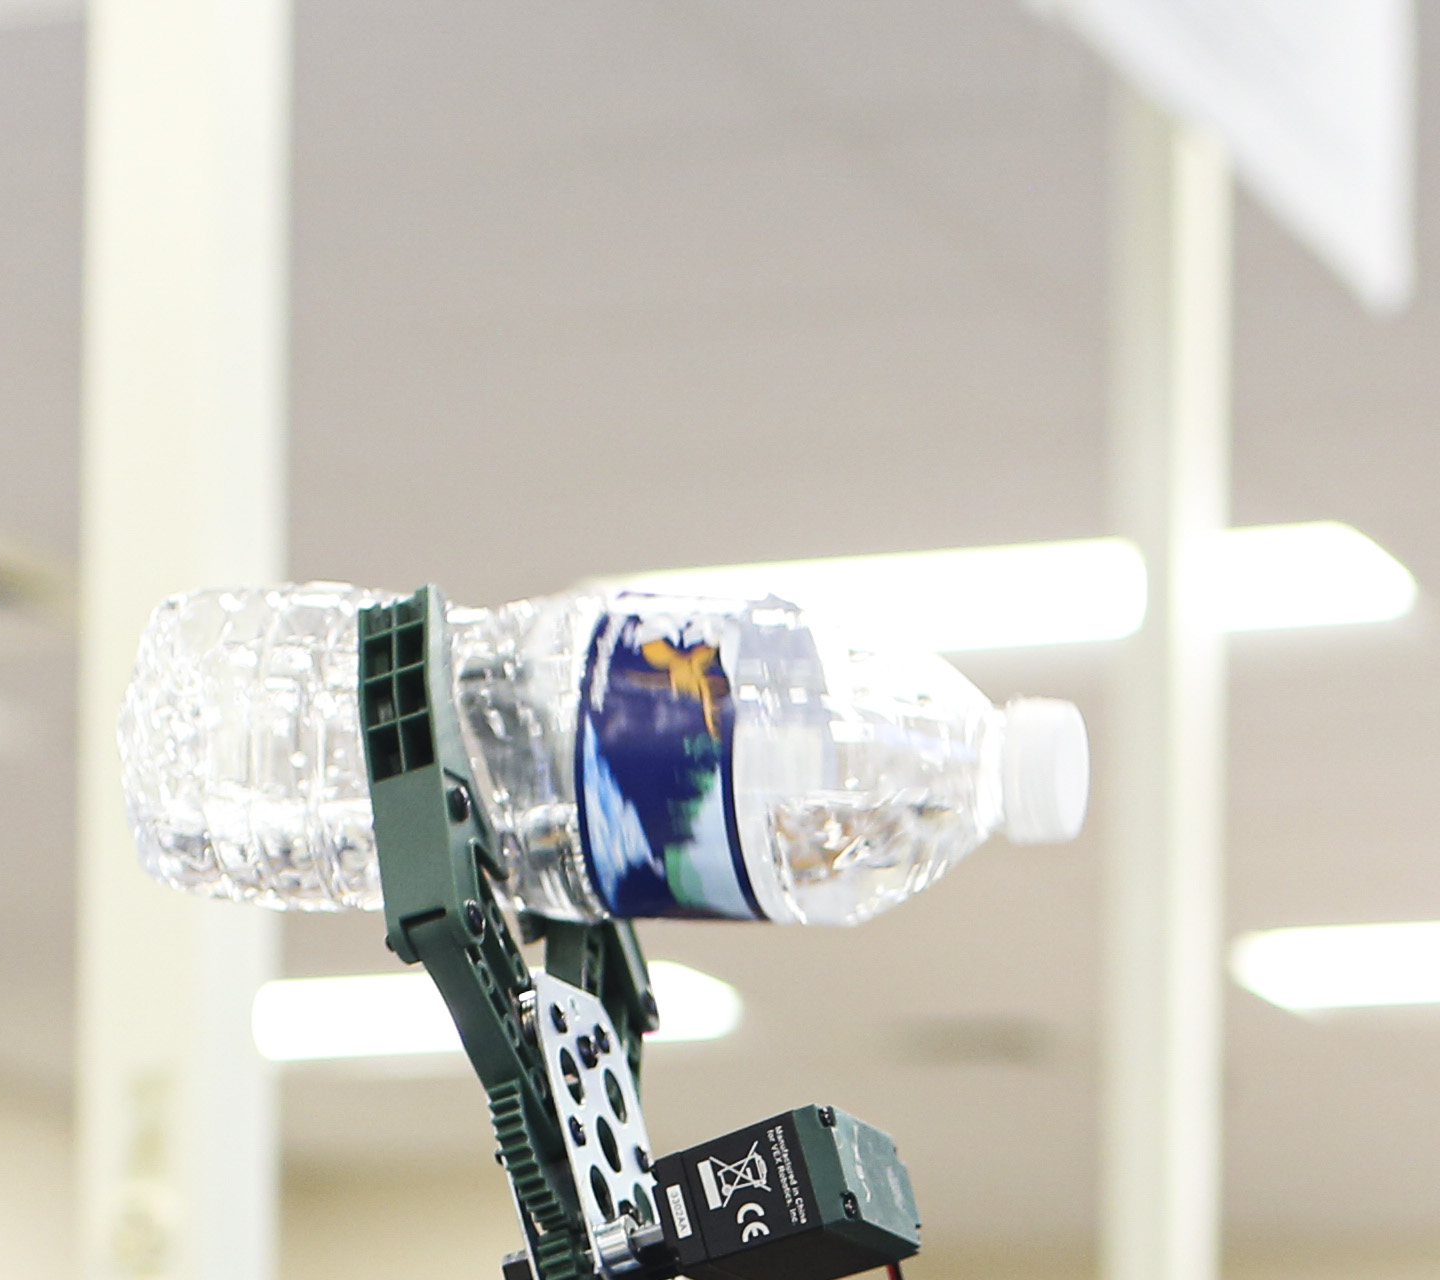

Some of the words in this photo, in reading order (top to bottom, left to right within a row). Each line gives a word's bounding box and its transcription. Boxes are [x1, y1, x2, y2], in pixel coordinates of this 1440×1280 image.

[767, 1129, 776, 1142] for
[771, 1143, 782, 1165] VEX
[775, 1125, 798, 1186] Manufactured
[792, 1187, 800, 1197] in
[795, 1197, 807, 1225] China
